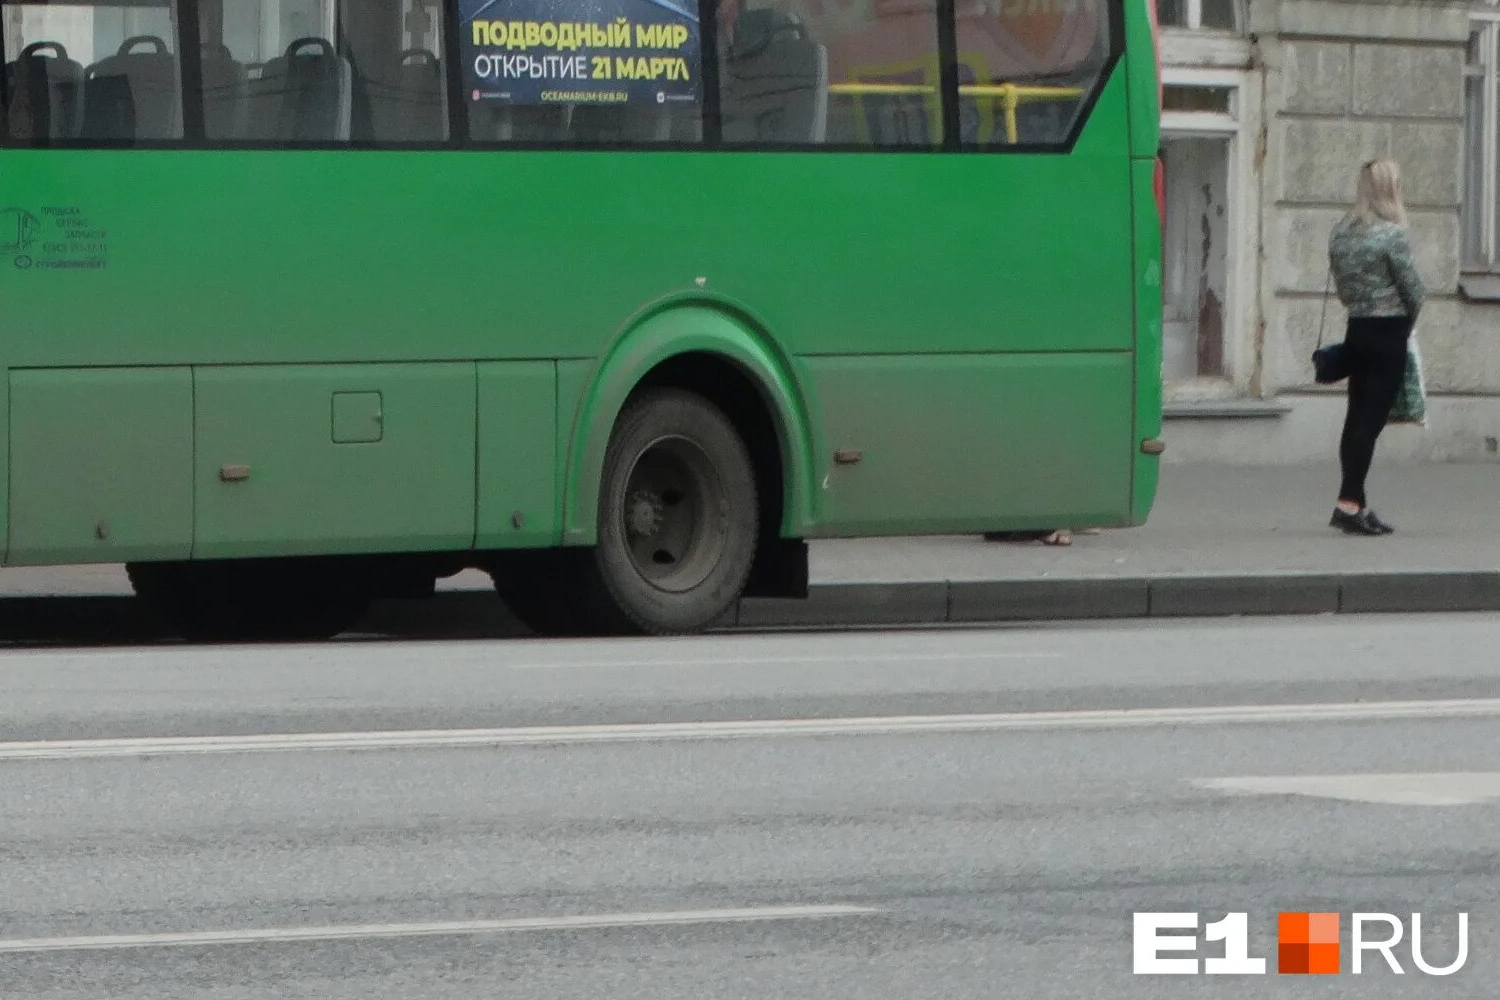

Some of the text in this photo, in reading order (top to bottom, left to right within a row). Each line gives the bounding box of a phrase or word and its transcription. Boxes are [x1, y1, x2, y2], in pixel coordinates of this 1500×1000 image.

[472, 17, 689, 51] ПОДВОДНЫЙ МИР
[474, 54, 588, 79] ОТКРЫТИЕ
[591, 56, 612, 79] 21
